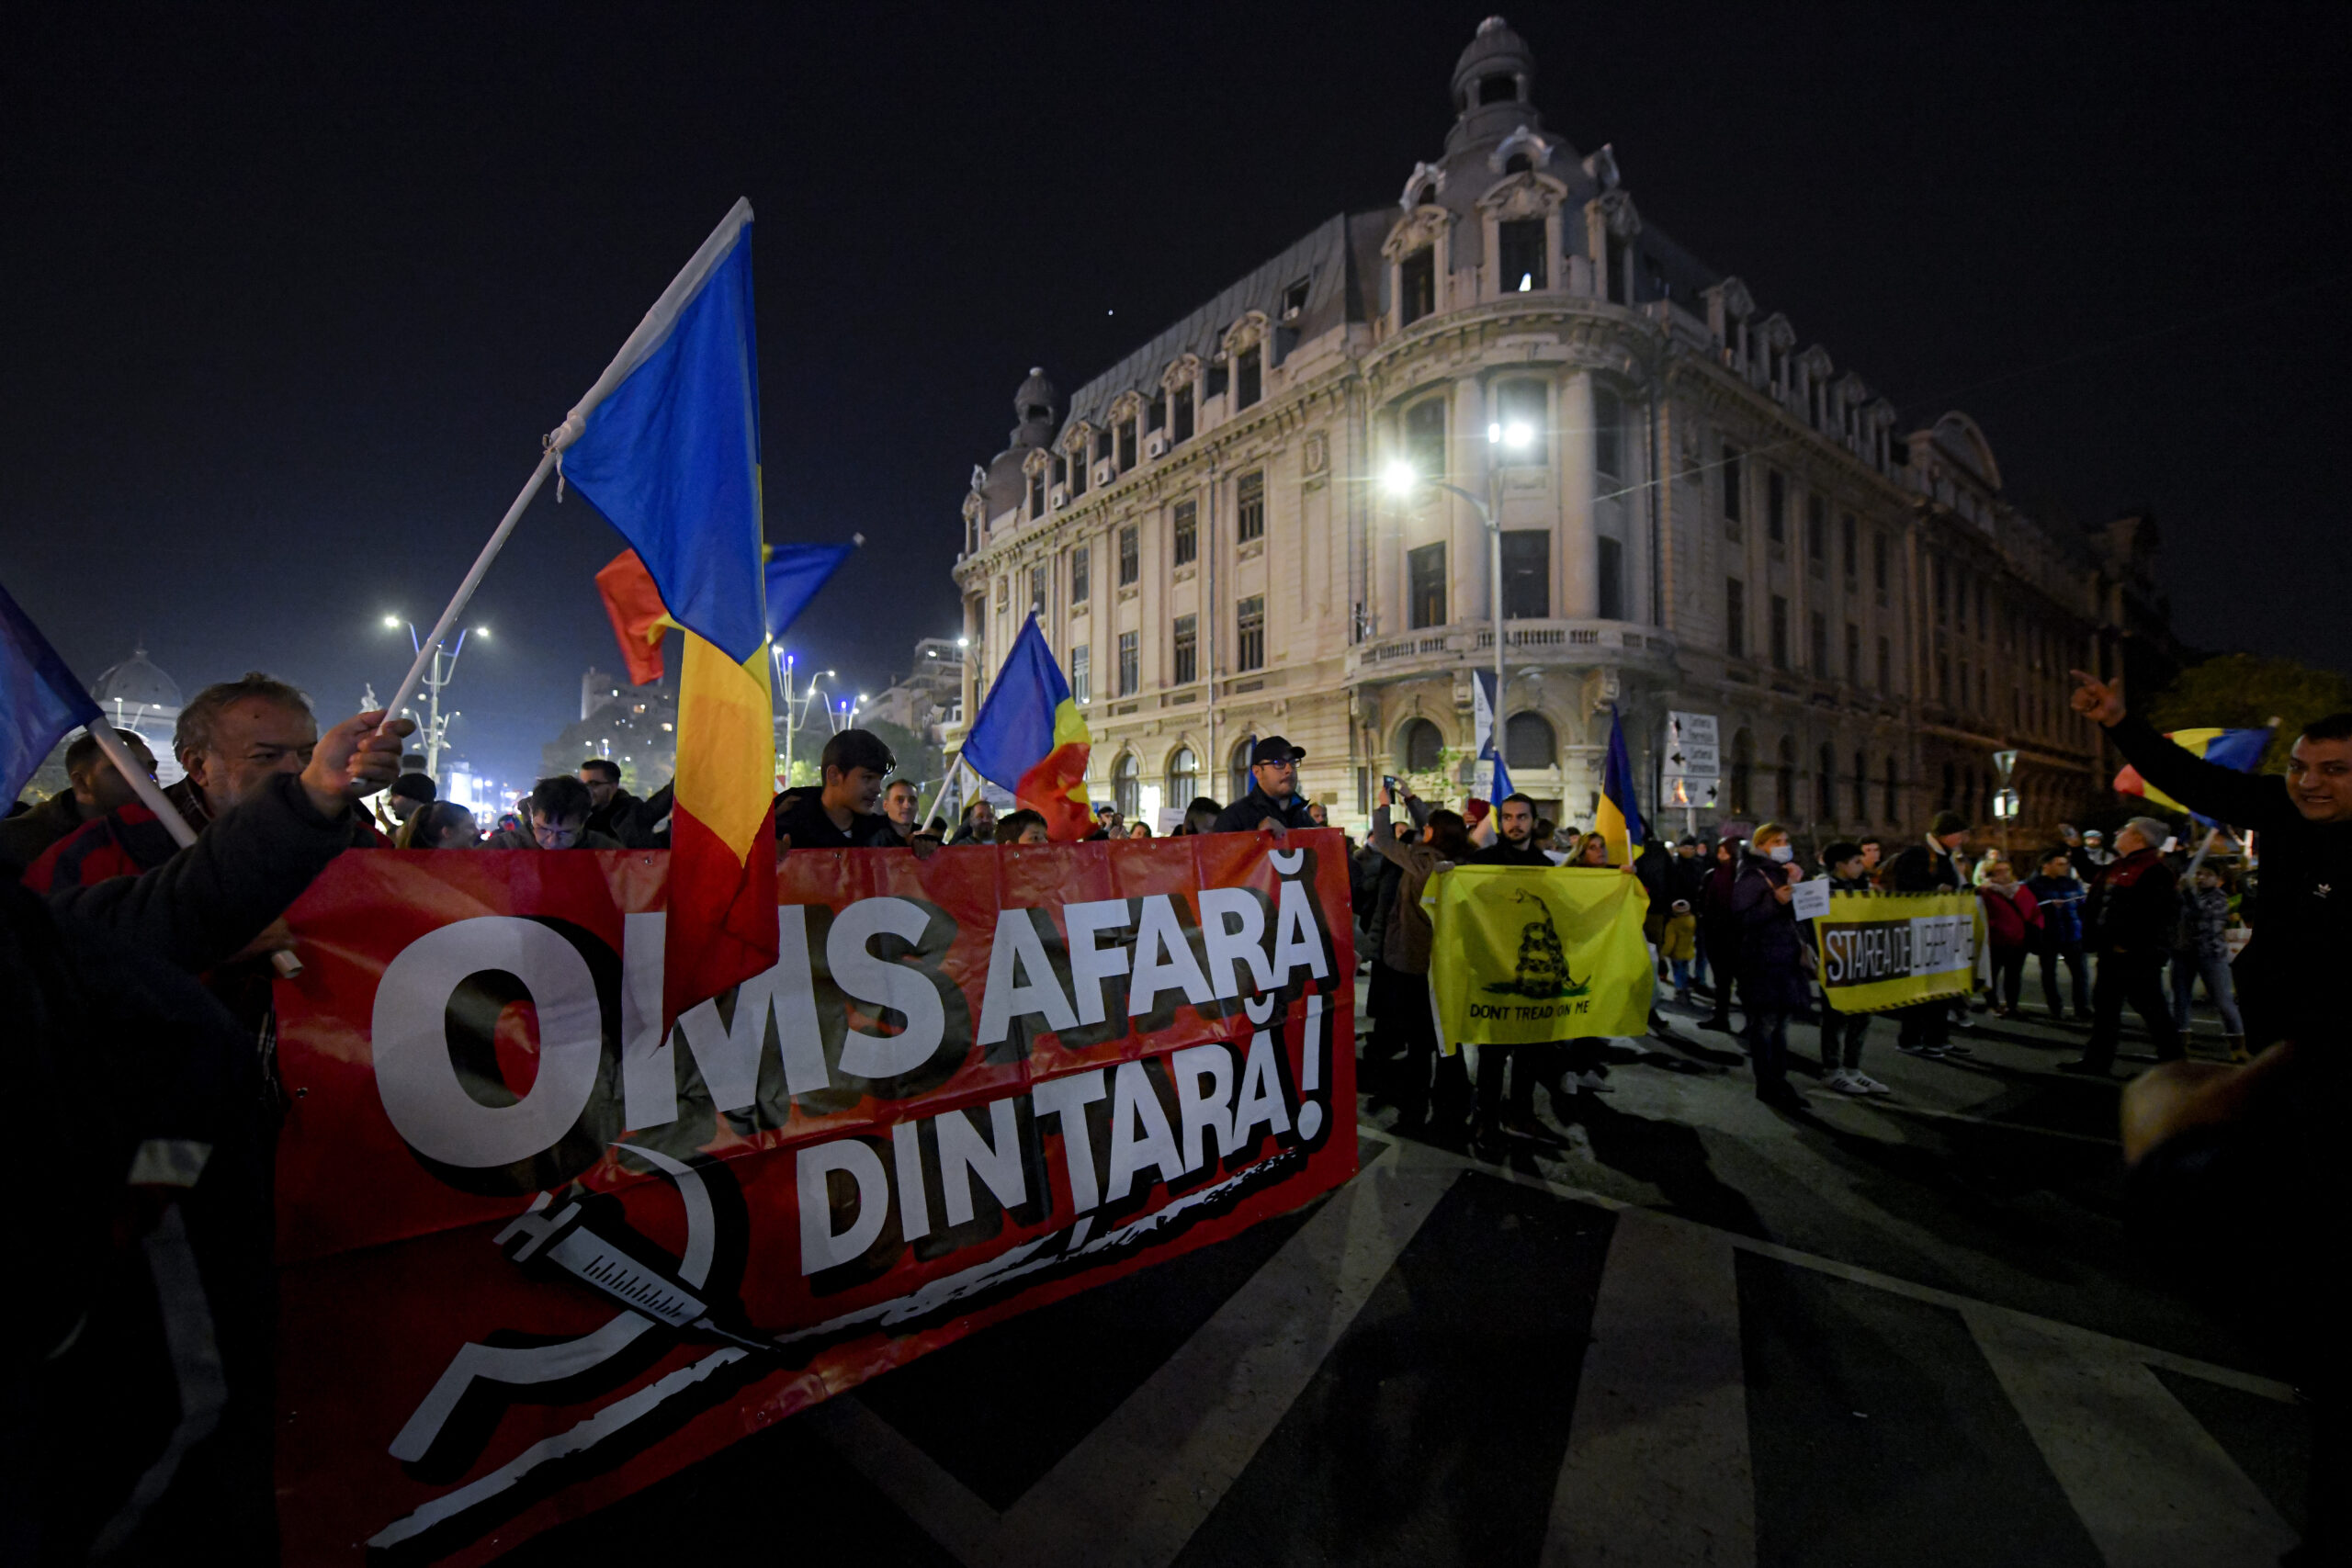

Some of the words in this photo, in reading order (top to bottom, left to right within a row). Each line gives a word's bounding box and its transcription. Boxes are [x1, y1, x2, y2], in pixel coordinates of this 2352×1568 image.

[371, 897, 944, 1168] OMS
[977, 847, 1329, 1048] AFARĂ
[1470, 1003, 1511, 1021] DONT
[1515, 1005, 1554, 1021] TREAD
[1557, 1002, 1572, 1017] ON
[1575, 999, 1590, 1015] ME
[1826, 928, 1892, 982] STAREA
[1893, 926, 1911, 974] DE
[797, 1099, 1028, 1276] DIN
